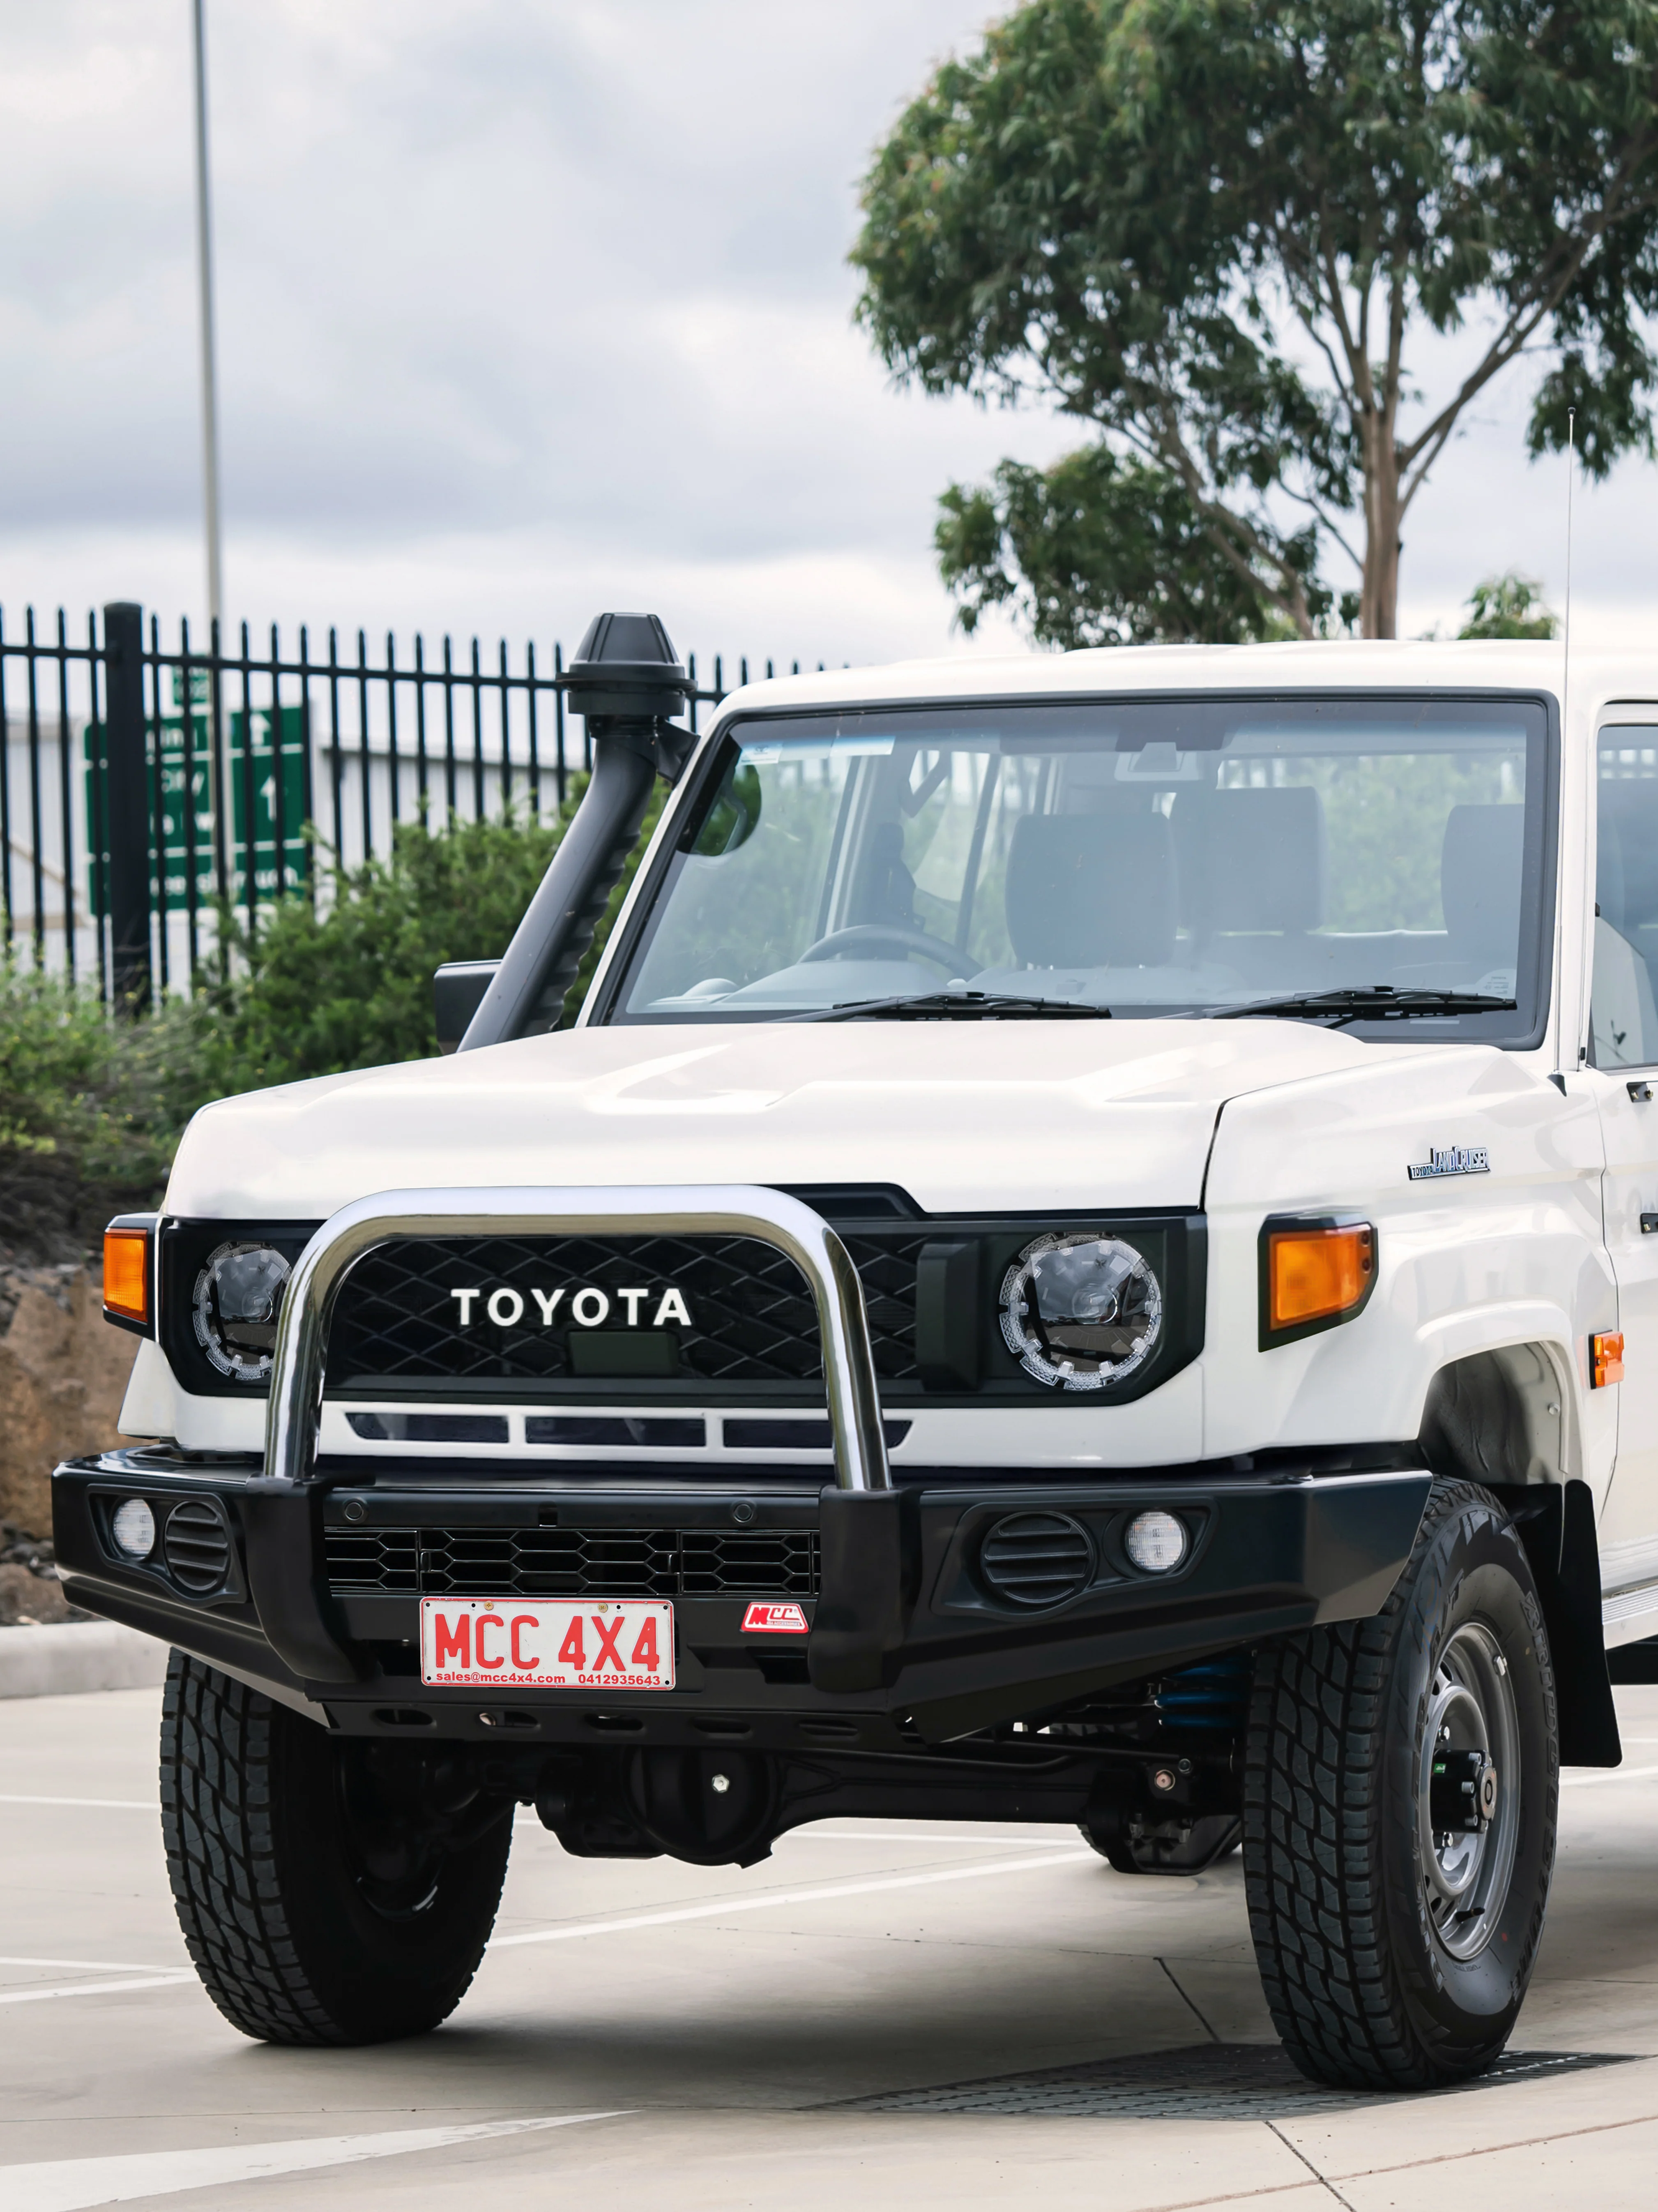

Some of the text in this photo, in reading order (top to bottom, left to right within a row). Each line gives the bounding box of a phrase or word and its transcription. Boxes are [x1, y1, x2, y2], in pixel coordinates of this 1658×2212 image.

[450, 1287, 692, 1327] TOYOTA
[748, 1607, 801, 1626] MCC
[435, 1613, 660, 1672] MCC 4X4
[436, 1671, 661, 1685] sales@mcc4x4.com 0412935643
